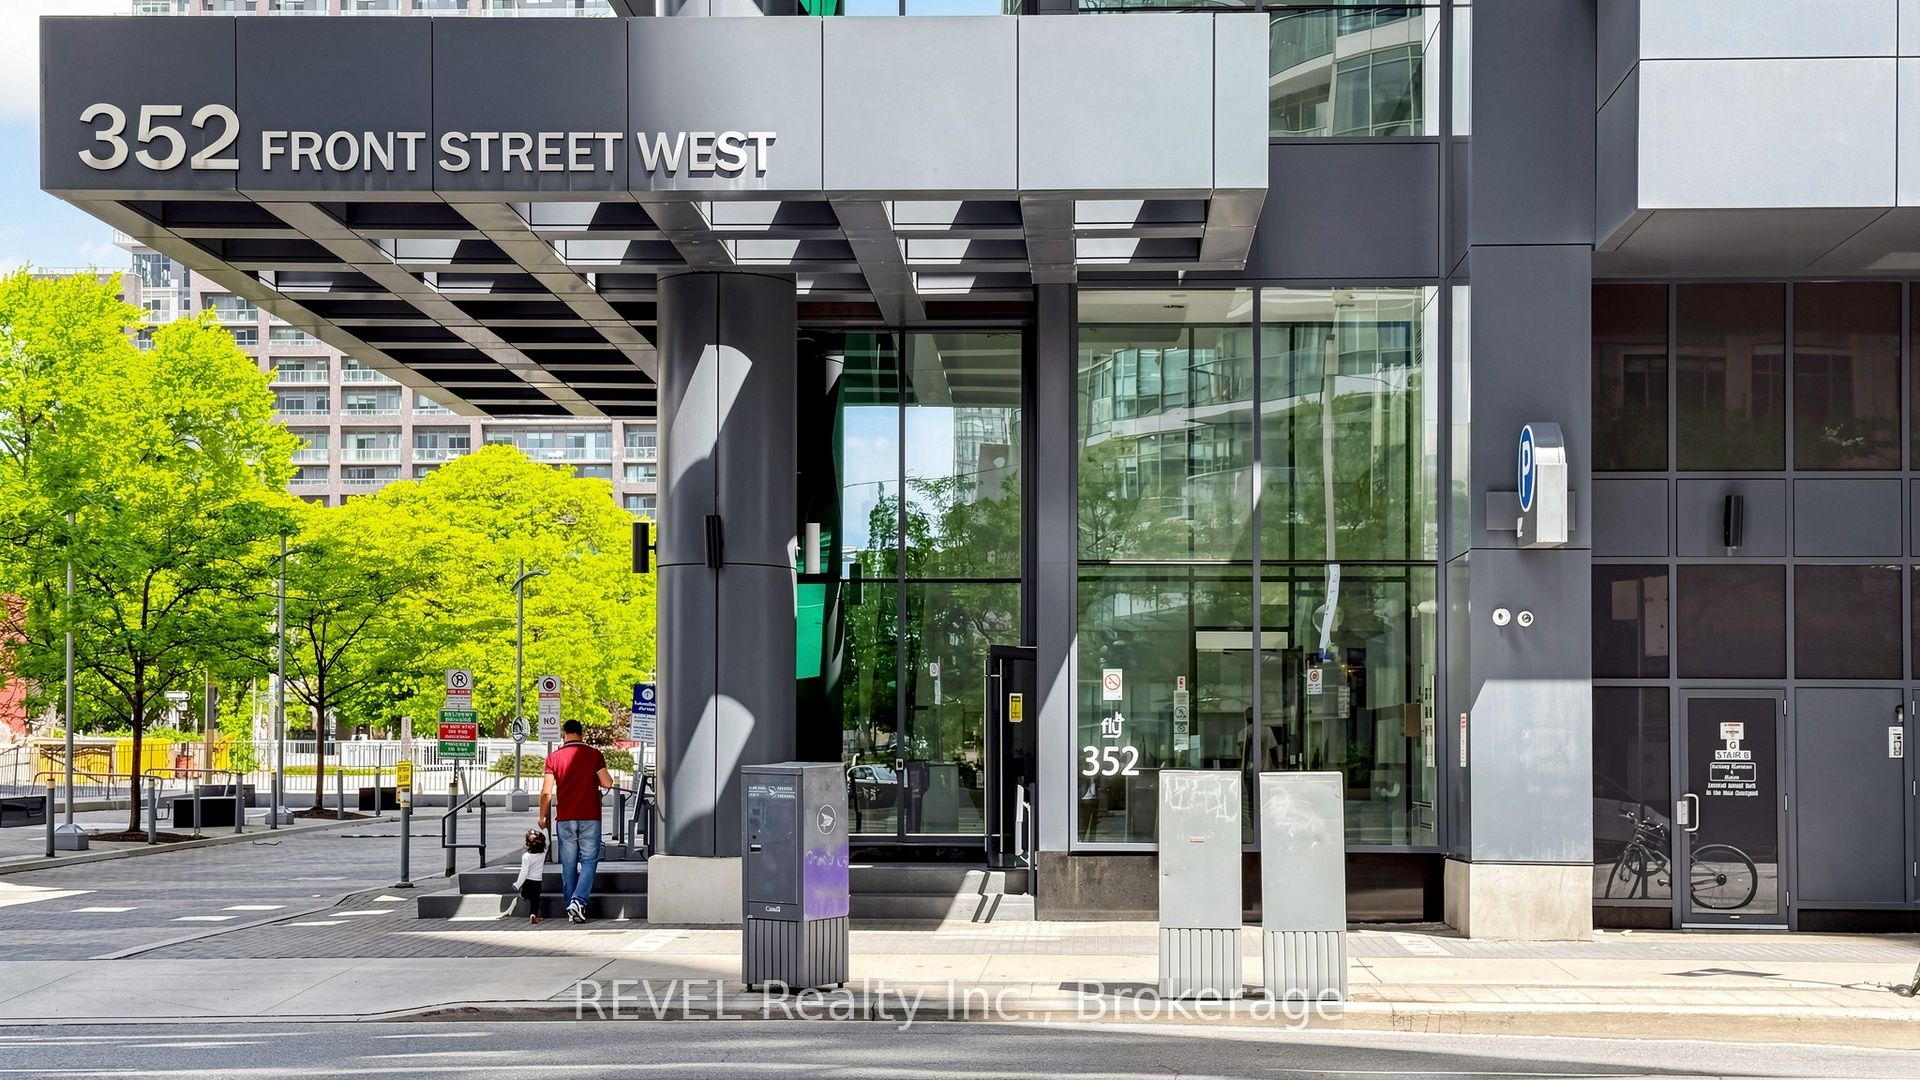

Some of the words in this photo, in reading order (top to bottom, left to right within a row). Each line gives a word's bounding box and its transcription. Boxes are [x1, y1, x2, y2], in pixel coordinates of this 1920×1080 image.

[78, 103, 240, 171] 352
[262, 131, 427, 172] FRONT
[438, 131, 624, 172] STREET
[636, 130, 777, 178] WEST
[543, 717, 557, 725] NO
[1101, 711, 1125, 738] fly
[1082, 745, 1140, 776] 352
